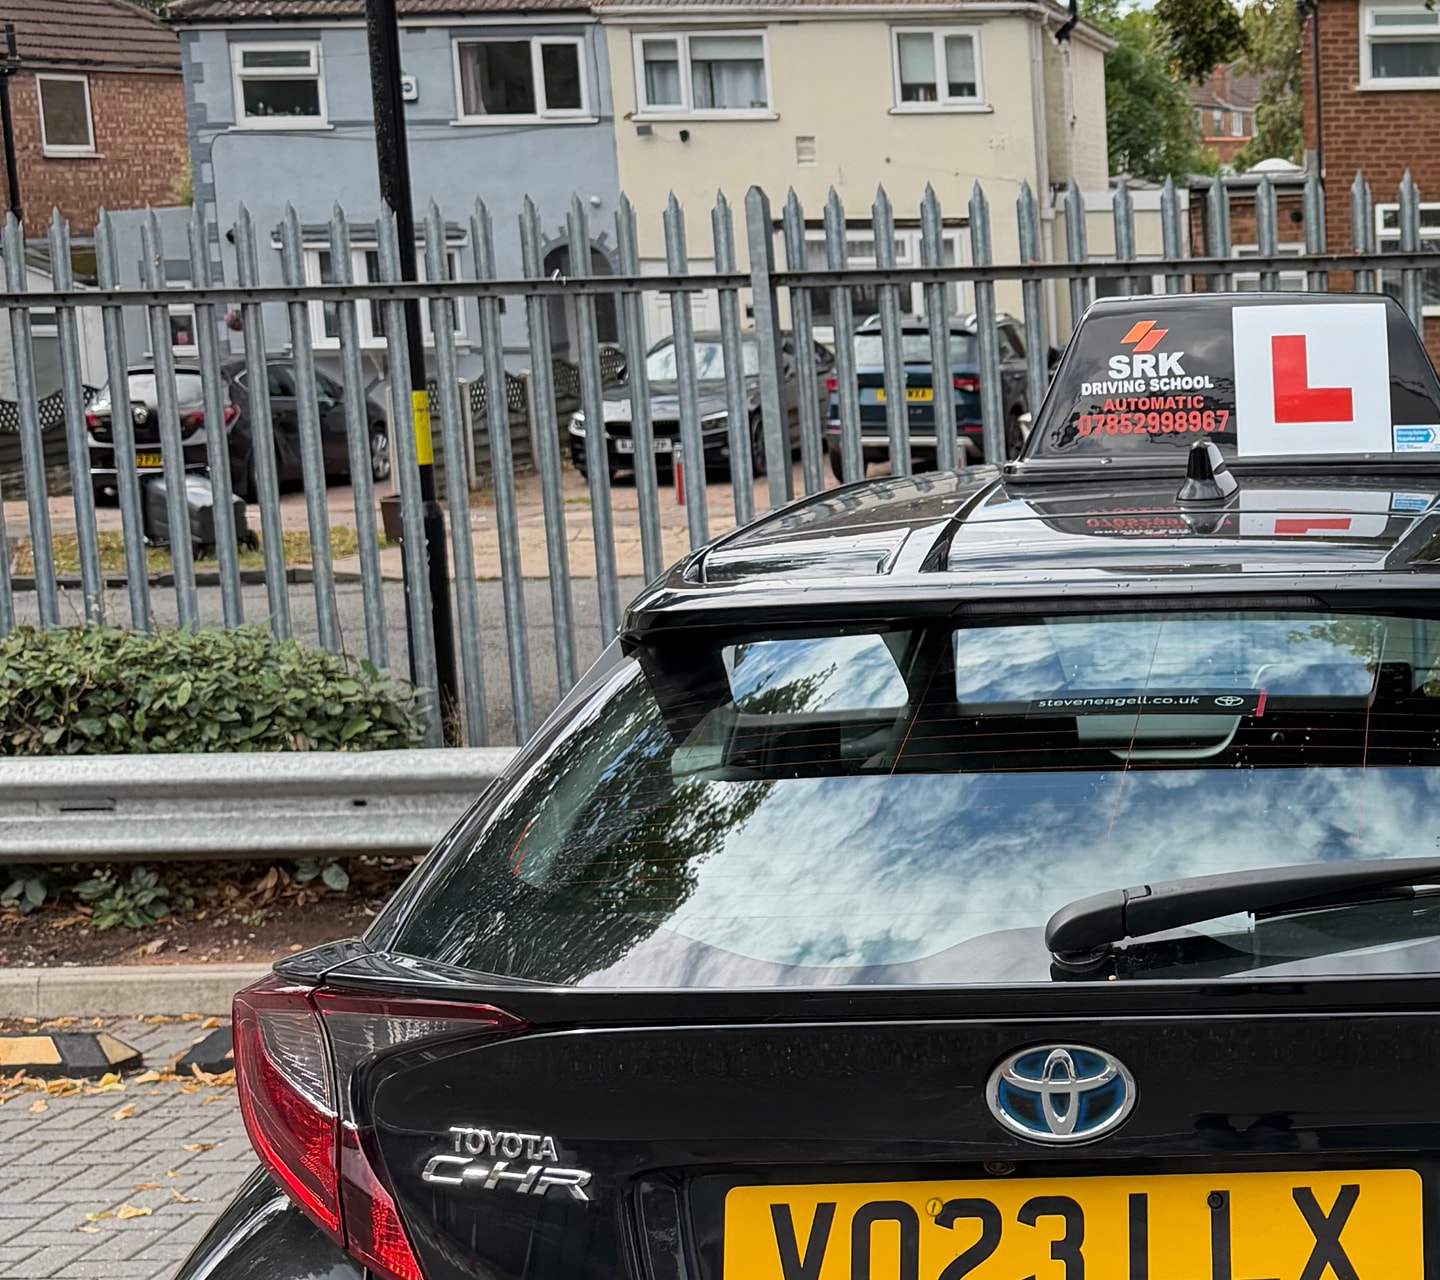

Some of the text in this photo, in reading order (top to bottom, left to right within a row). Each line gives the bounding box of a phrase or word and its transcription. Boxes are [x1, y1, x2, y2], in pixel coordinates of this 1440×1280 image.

[1107, 351, 1186, 379] SRK
[1271, 334, 1353, 423] L
[1081, 375, 1214, 396] DRIVING SCHOOL
[1102, 395, 1205, 412] AUTOMATIC
[1077, 409, 1230, 438] 07852998967
[1037, 695, 1200, 708] steveneagell.co.uk
[449, 1126, 558, 1162] TOYOTA
